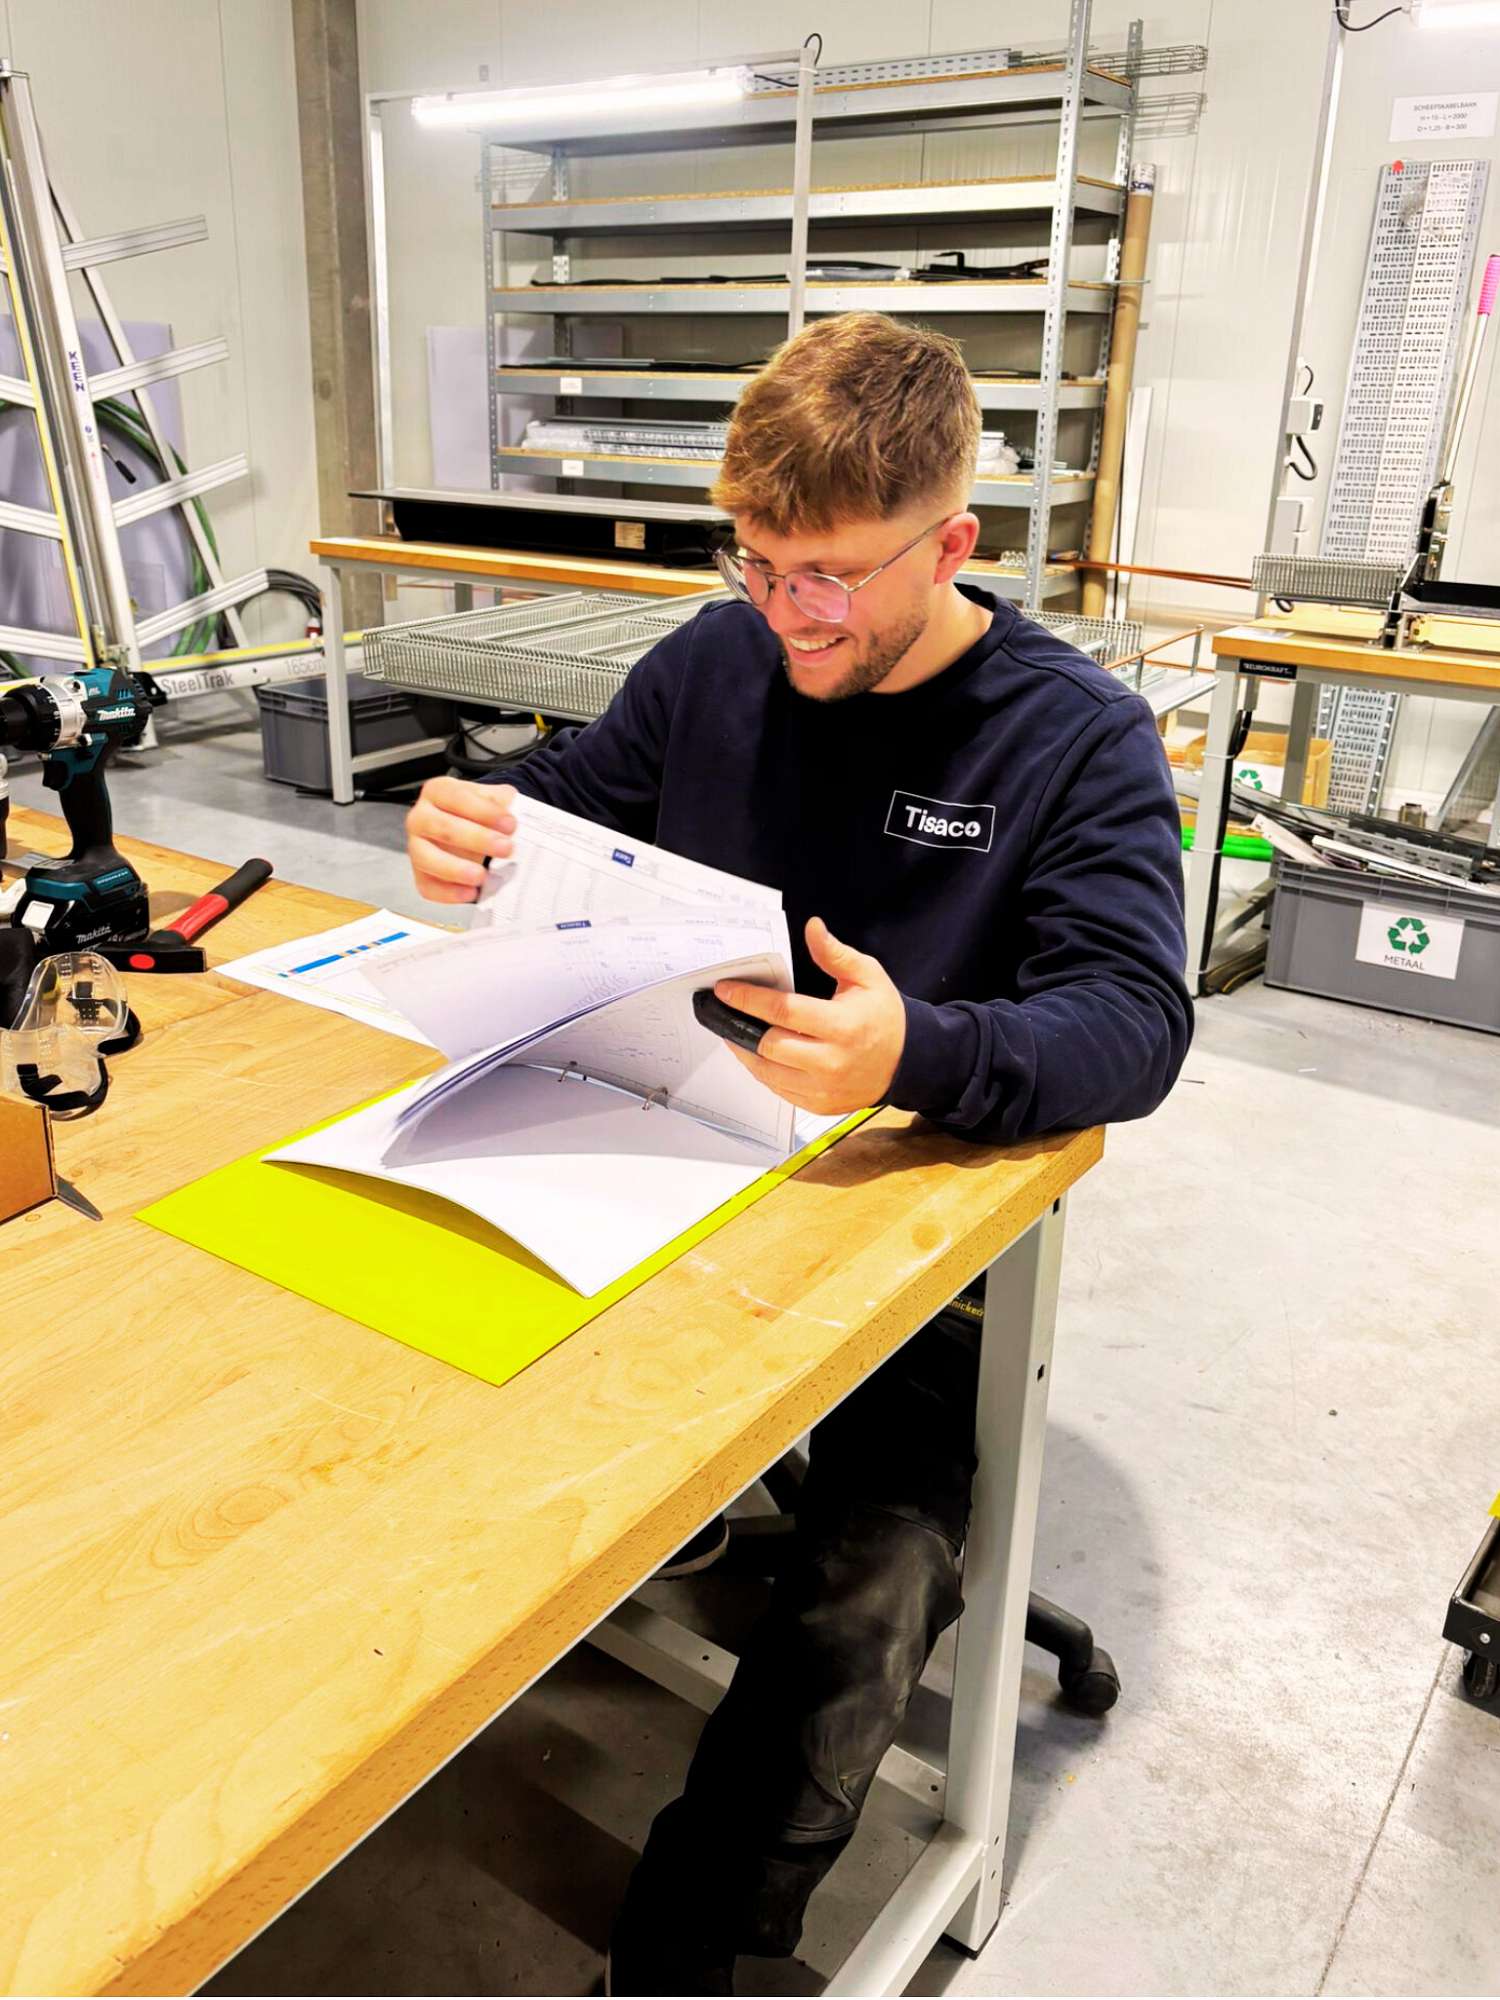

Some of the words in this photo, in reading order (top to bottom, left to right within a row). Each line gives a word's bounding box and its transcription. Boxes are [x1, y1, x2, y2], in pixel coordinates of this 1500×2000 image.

[161, 671, 235, 695] SteelTrak
[905, 805, 981, 838] Tisaco
[1384, 954, 1425, 970] METAAL
